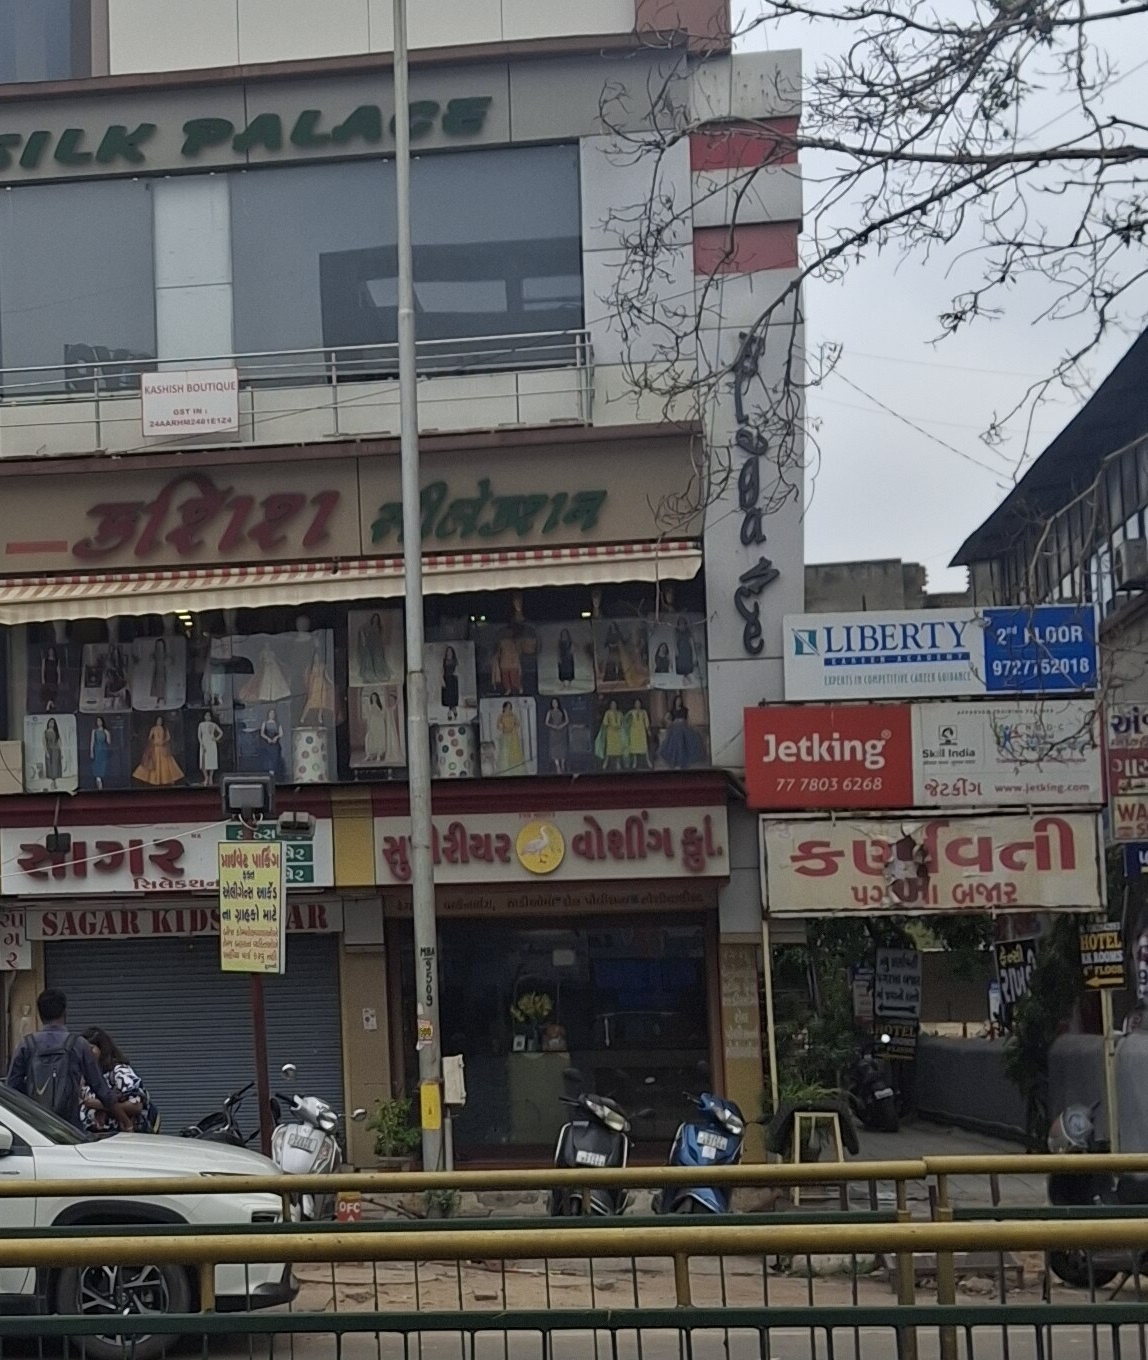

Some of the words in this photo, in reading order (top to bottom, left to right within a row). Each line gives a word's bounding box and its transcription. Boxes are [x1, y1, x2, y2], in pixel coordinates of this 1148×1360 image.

[181, 96, 493, 157] PALACE
[144, 383, 184, 395] KASHISH
[186, 381, 236, 393] BOUTIQUE
[172, 408, 191, 416] GST
[823, 620, 970, 653] LIBERTY
[1023, 625, 1084, 646] FLOOR
[824, 676, 852, 686] EXPERTS
[763, 733, 887, 769] Jetking
[948, 748, 976, 758] India
[776, 779, 796, 792] 77
[799, 778, 839, 792] 7803
[843, 777, 883, 791] 6268
[994, 782, 1091, 794] www.jetking.com
[18, 838, 186, 880] સાગર
[382, 821, 513, 882] સુીરીયર
[952, 881, 1018, 903] બજાર
[42, 909, 140, 937] SAGAR
[284, 904, 329, 930] AR
[1080, 932, 1123, 950] HOTEL
[339, 1201, 361, 1214] OFC
